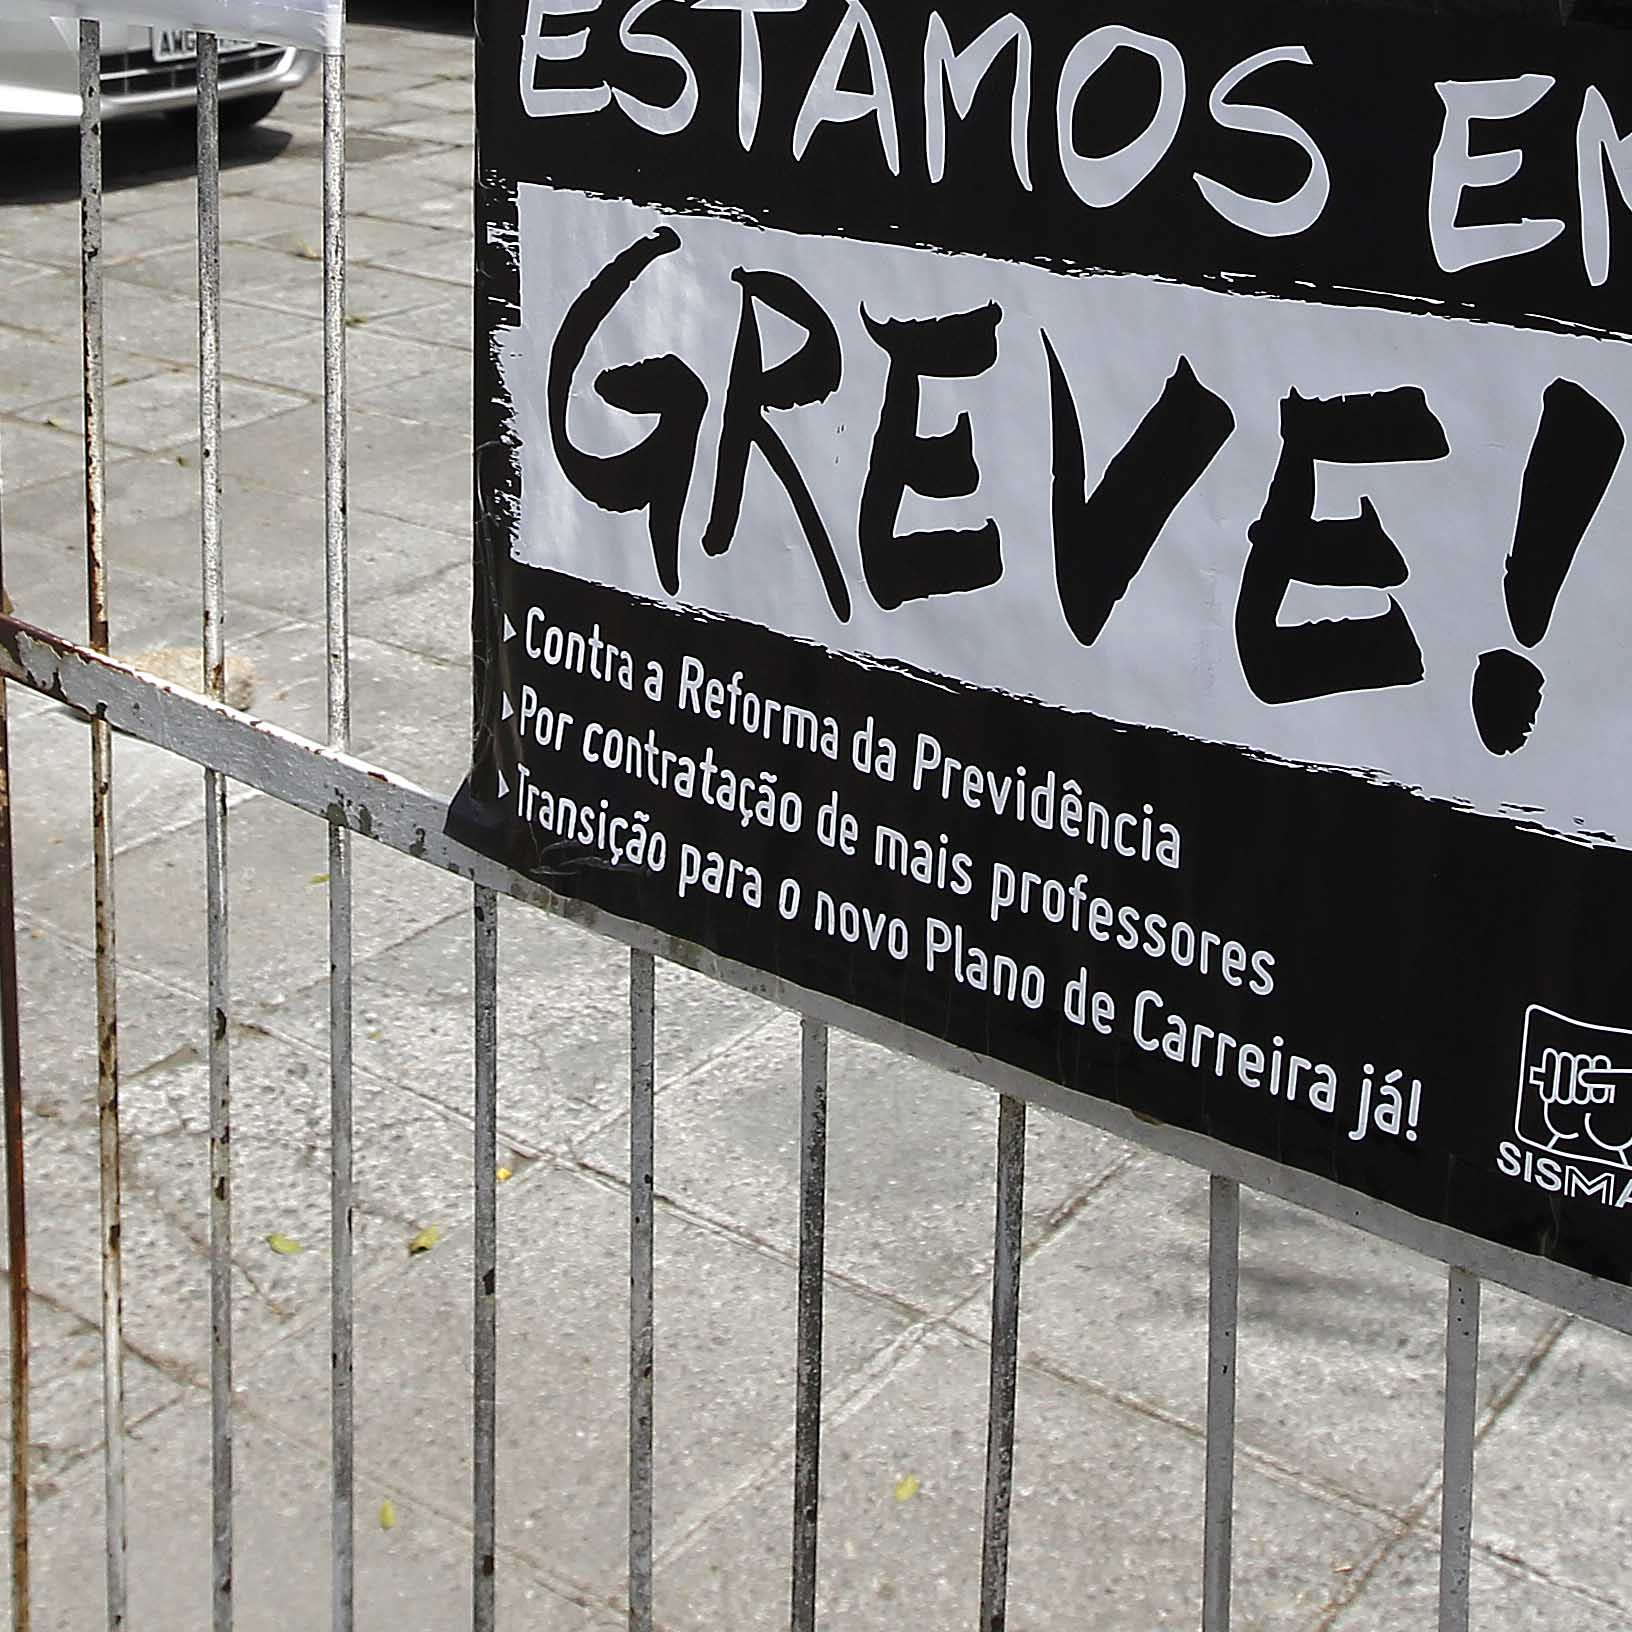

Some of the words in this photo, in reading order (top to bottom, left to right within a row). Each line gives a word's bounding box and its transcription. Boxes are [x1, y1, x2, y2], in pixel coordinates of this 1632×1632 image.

[547, 226, 1626, 757] GREVE!
[520, 684, 574, 752] Por
[582, 722, 802, 833] contratação
[817, 791, 858, 856] de
[875, 824, 973, 896] mais
[990, 862, 1276, 996] professores
[523, 607, 633, 691] Contra
[645, 660, 664, 702] a
[678, 655, 839, 761] Reforma
[852, 716, 896, 782] da
[913, 733, 1181, 869] Previdência
[518, 762, 667, 873] Transição
[678, 843, 762, 909] para
[778, 878, 801, 920] o
[815, 890, 909, 961] novo
[926, 917, 1045, 1009] Plano
[1063, 966, 1116, 1035] de
[1133, 989, 1338, 1114] Carreira
[1348, 1063, 1423, 1142] já!
